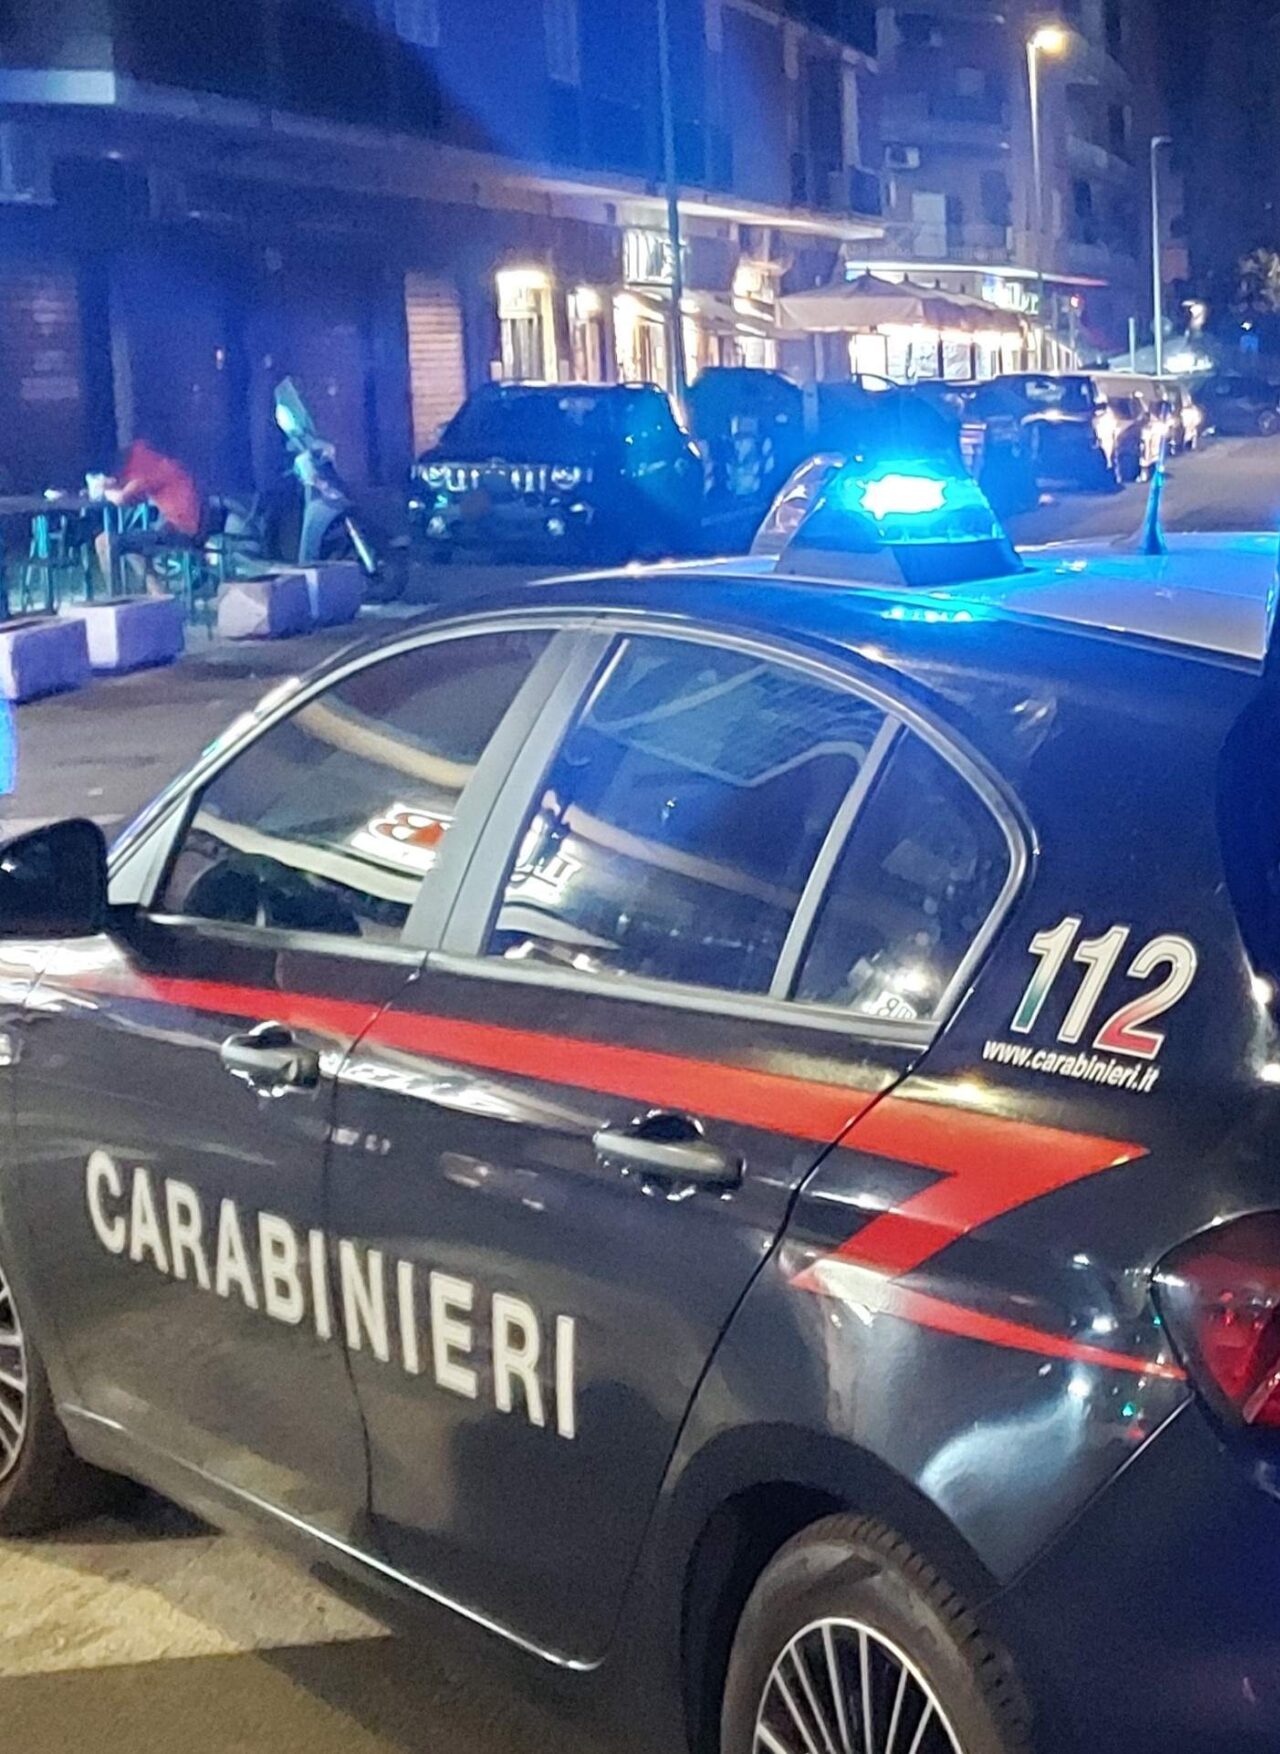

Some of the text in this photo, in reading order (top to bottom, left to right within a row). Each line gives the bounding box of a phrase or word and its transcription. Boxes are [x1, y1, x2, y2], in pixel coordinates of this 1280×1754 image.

[1011, 916, 1197, 1060] 112
[983, 1040, 1160, 1093] www.carabinieri.it
[87, 1150, 576, 1438] CARABINIERI
